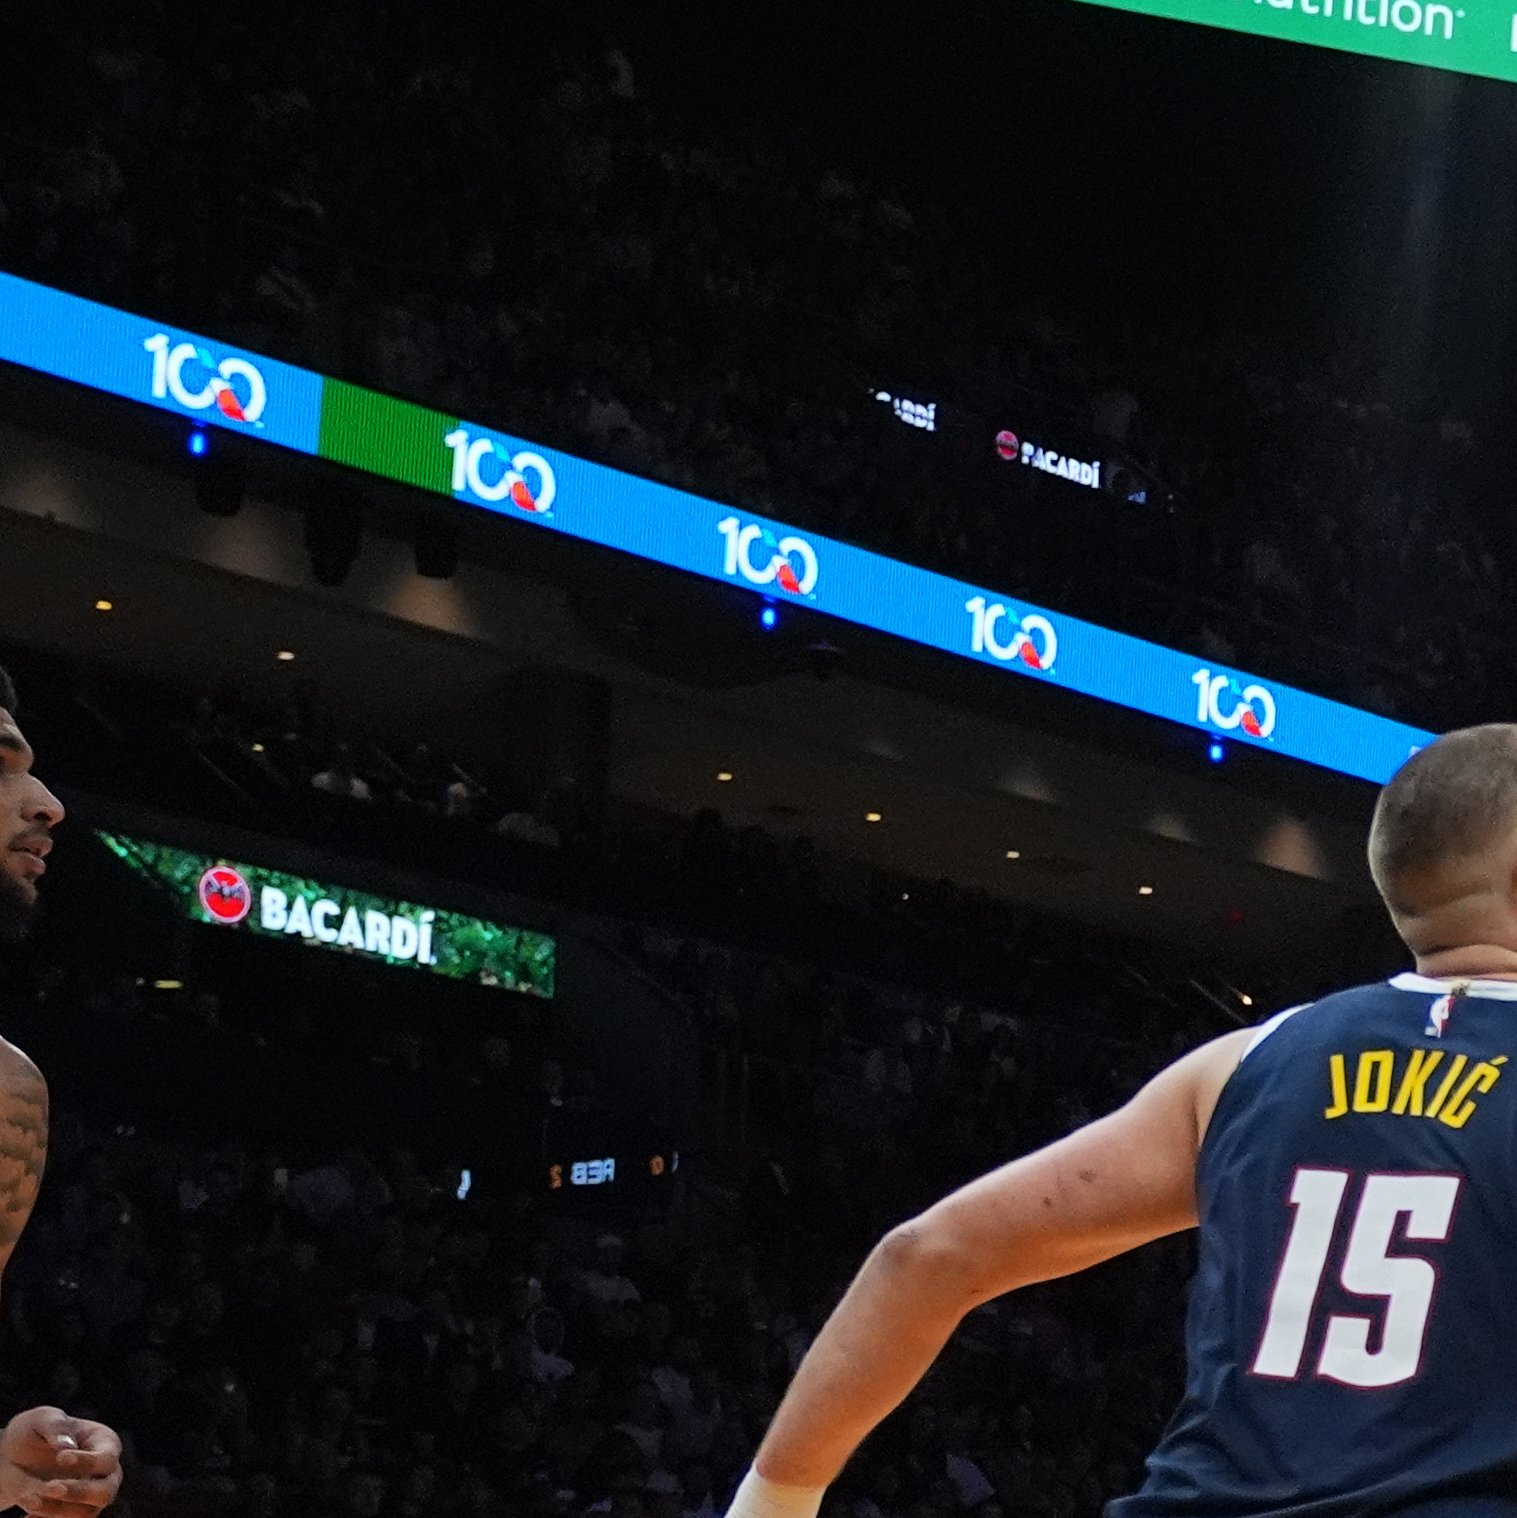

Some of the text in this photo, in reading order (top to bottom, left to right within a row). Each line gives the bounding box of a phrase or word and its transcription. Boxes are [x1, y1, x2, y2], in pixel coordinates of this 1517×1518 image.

[1254, 0, 1454, 39] ition
[144, 333, 267, 421] 100
[445, 429, 556, 512] 100
[717, 516, 818, 595] 100
[965, 596, 1057, 670] 100
[1192, 668, 1277, 739] 100
[261, 884, 436, 965] BACARDÍ
[1324, 1048, 1508, 1130] JOKIĆ
[1252, 1166, 1464, 1390] 15
